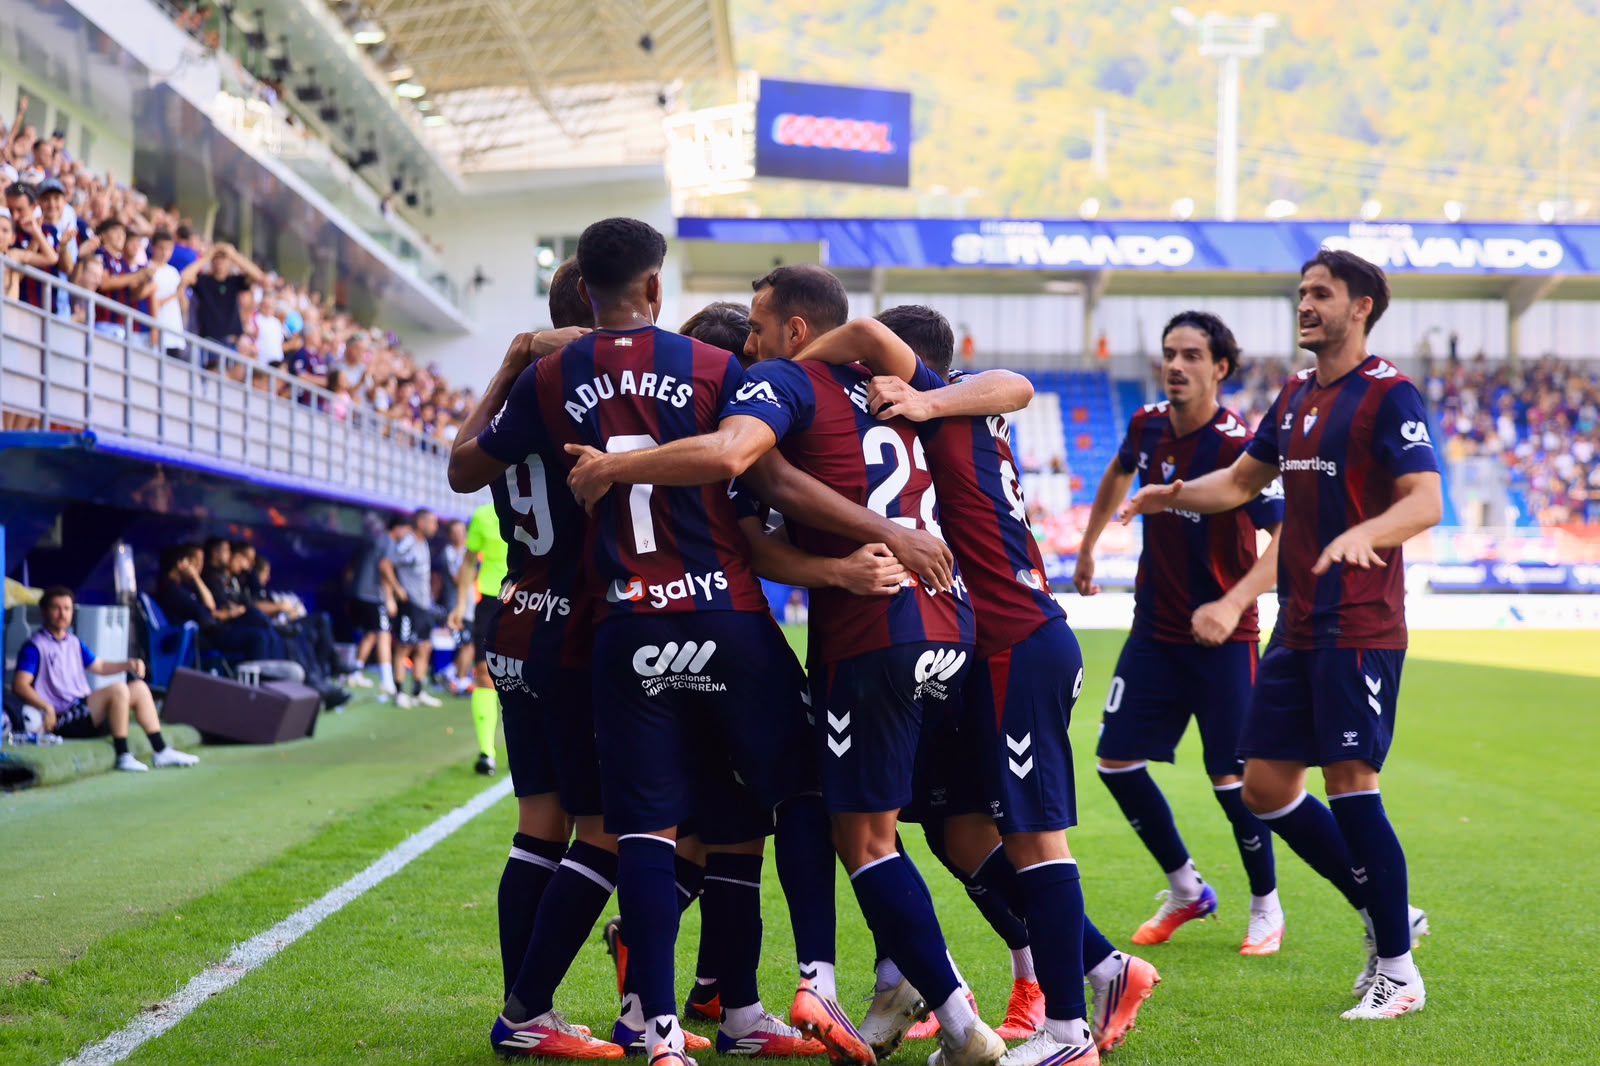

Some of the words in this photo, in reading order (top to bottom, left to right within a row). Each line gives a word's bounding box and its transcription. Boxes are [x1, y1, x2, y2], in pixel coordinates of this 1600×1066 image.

[952, 233, 1194, 267] SERVANDO
[564, 373, 615, 424] ADU
[620, 370, 693, 408] ARES
[1286, 456, 1337, 477] smartlog
[505, 453, 554, 556] 9
[606, 434, 661, 555] 7
[514, 588, 570, 622] galys
[648, 571, 728, 609] galys
